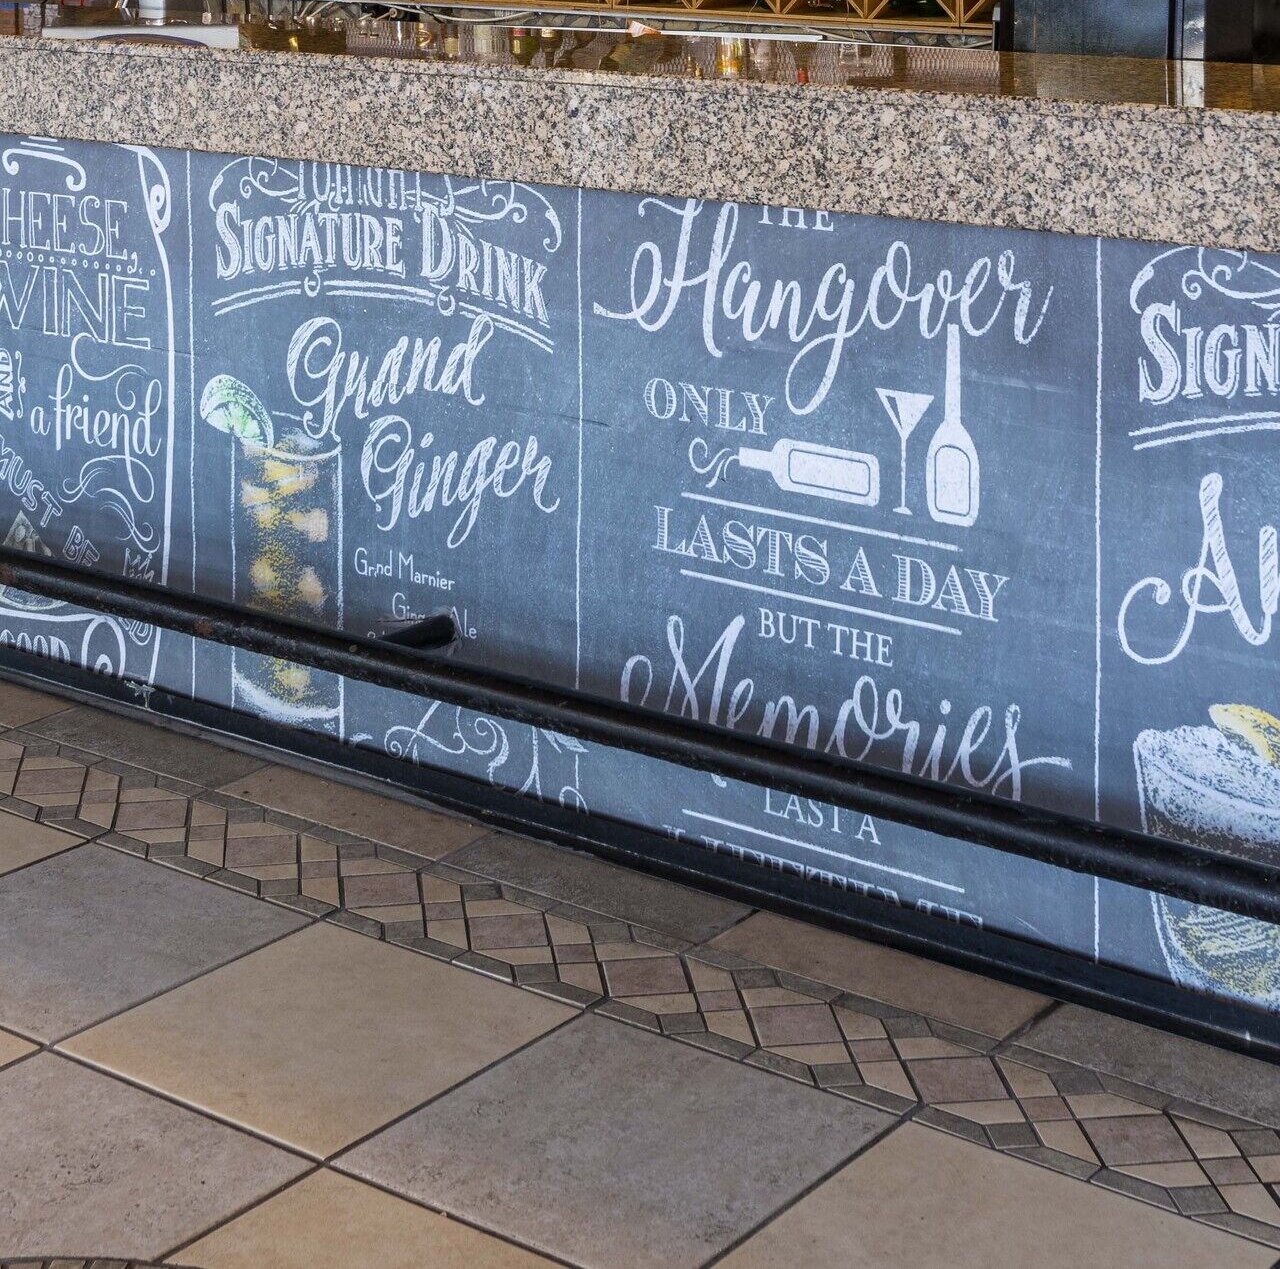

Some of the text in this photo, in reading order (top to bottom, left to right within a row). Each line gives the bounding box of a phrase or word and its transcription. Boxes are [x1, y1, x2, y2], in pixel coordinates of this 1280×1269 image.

[215, 201, 551, 328] SIGNATURE DRINK
[593, 199, 1054, 417] Hangover
[53, 363, 163, 504] friend
[287, 313, 493, 442] Grand
[642, 376, 777, 436] ONLY
[361, 413, 560, 549] Ginger
[398, 554, 455, 592] Marnier
[652, 506, 1011, 623] LASTS DAY
[758, 606, 894, 668] BUT THE
[621, 615, 1072, 801] Memories
